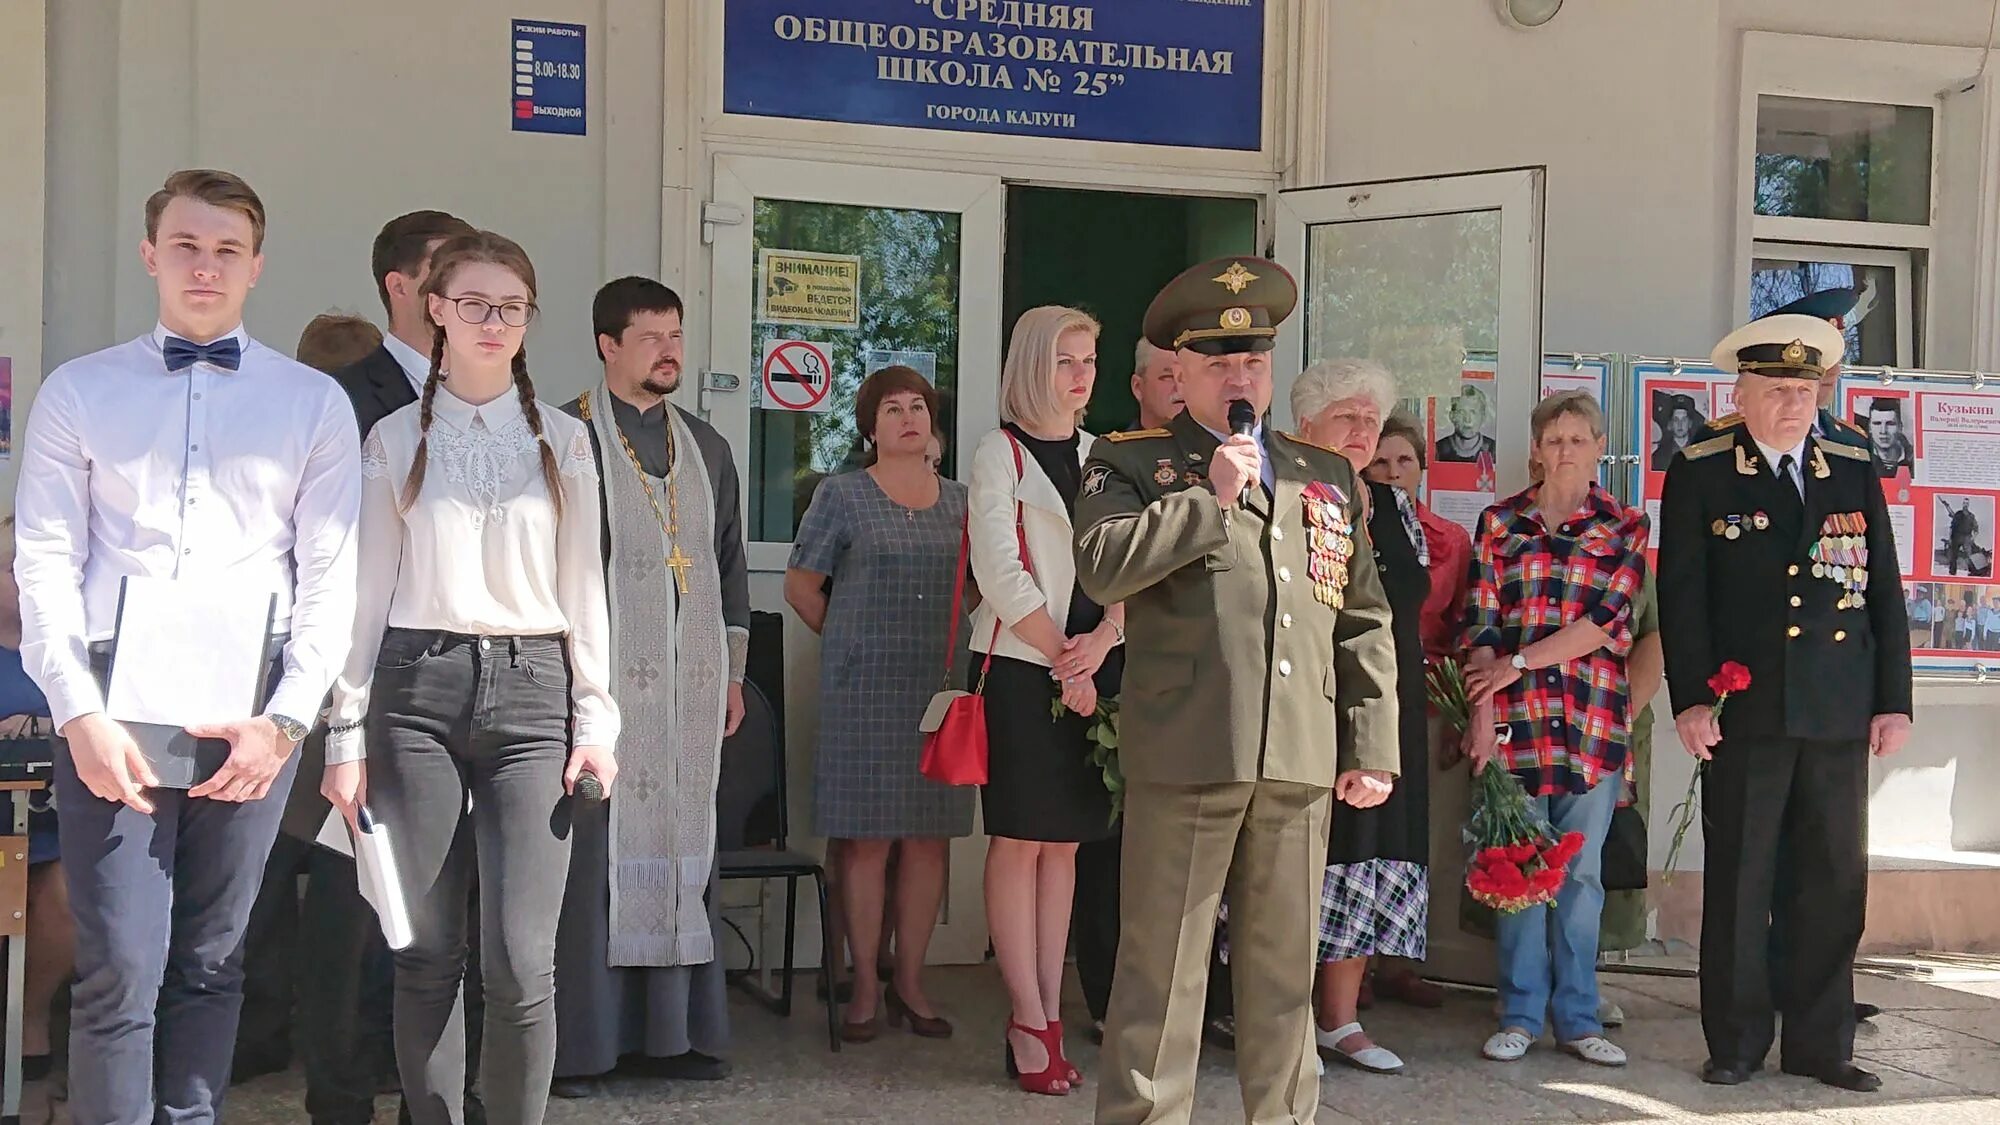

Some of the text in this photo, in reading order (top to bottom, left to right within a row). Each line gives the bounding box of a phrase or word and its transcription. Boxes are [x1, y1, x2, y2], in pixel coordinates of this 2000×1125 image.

[516, 25, 546, 34] РЕЖИМ
[773, 14, 1234, 75] ОБЩЕОБРАЗОВАТЕЛЬНАЯ
[535, 61, 580, 79] 8.00-18.30
[876, 55, 1014, 91] ШКОЛА
[1023, 67, 1061, 94] №
[533, 106, 582, 117] ВЫХОДНОЙ
[926, 103, 1077, 129] ГОРОДА КАЛУГИ
[775, 262, 849, 277] ВНИМАНИЕ!
[807, 294, 852, 304] ВЕДЕТСЯ
